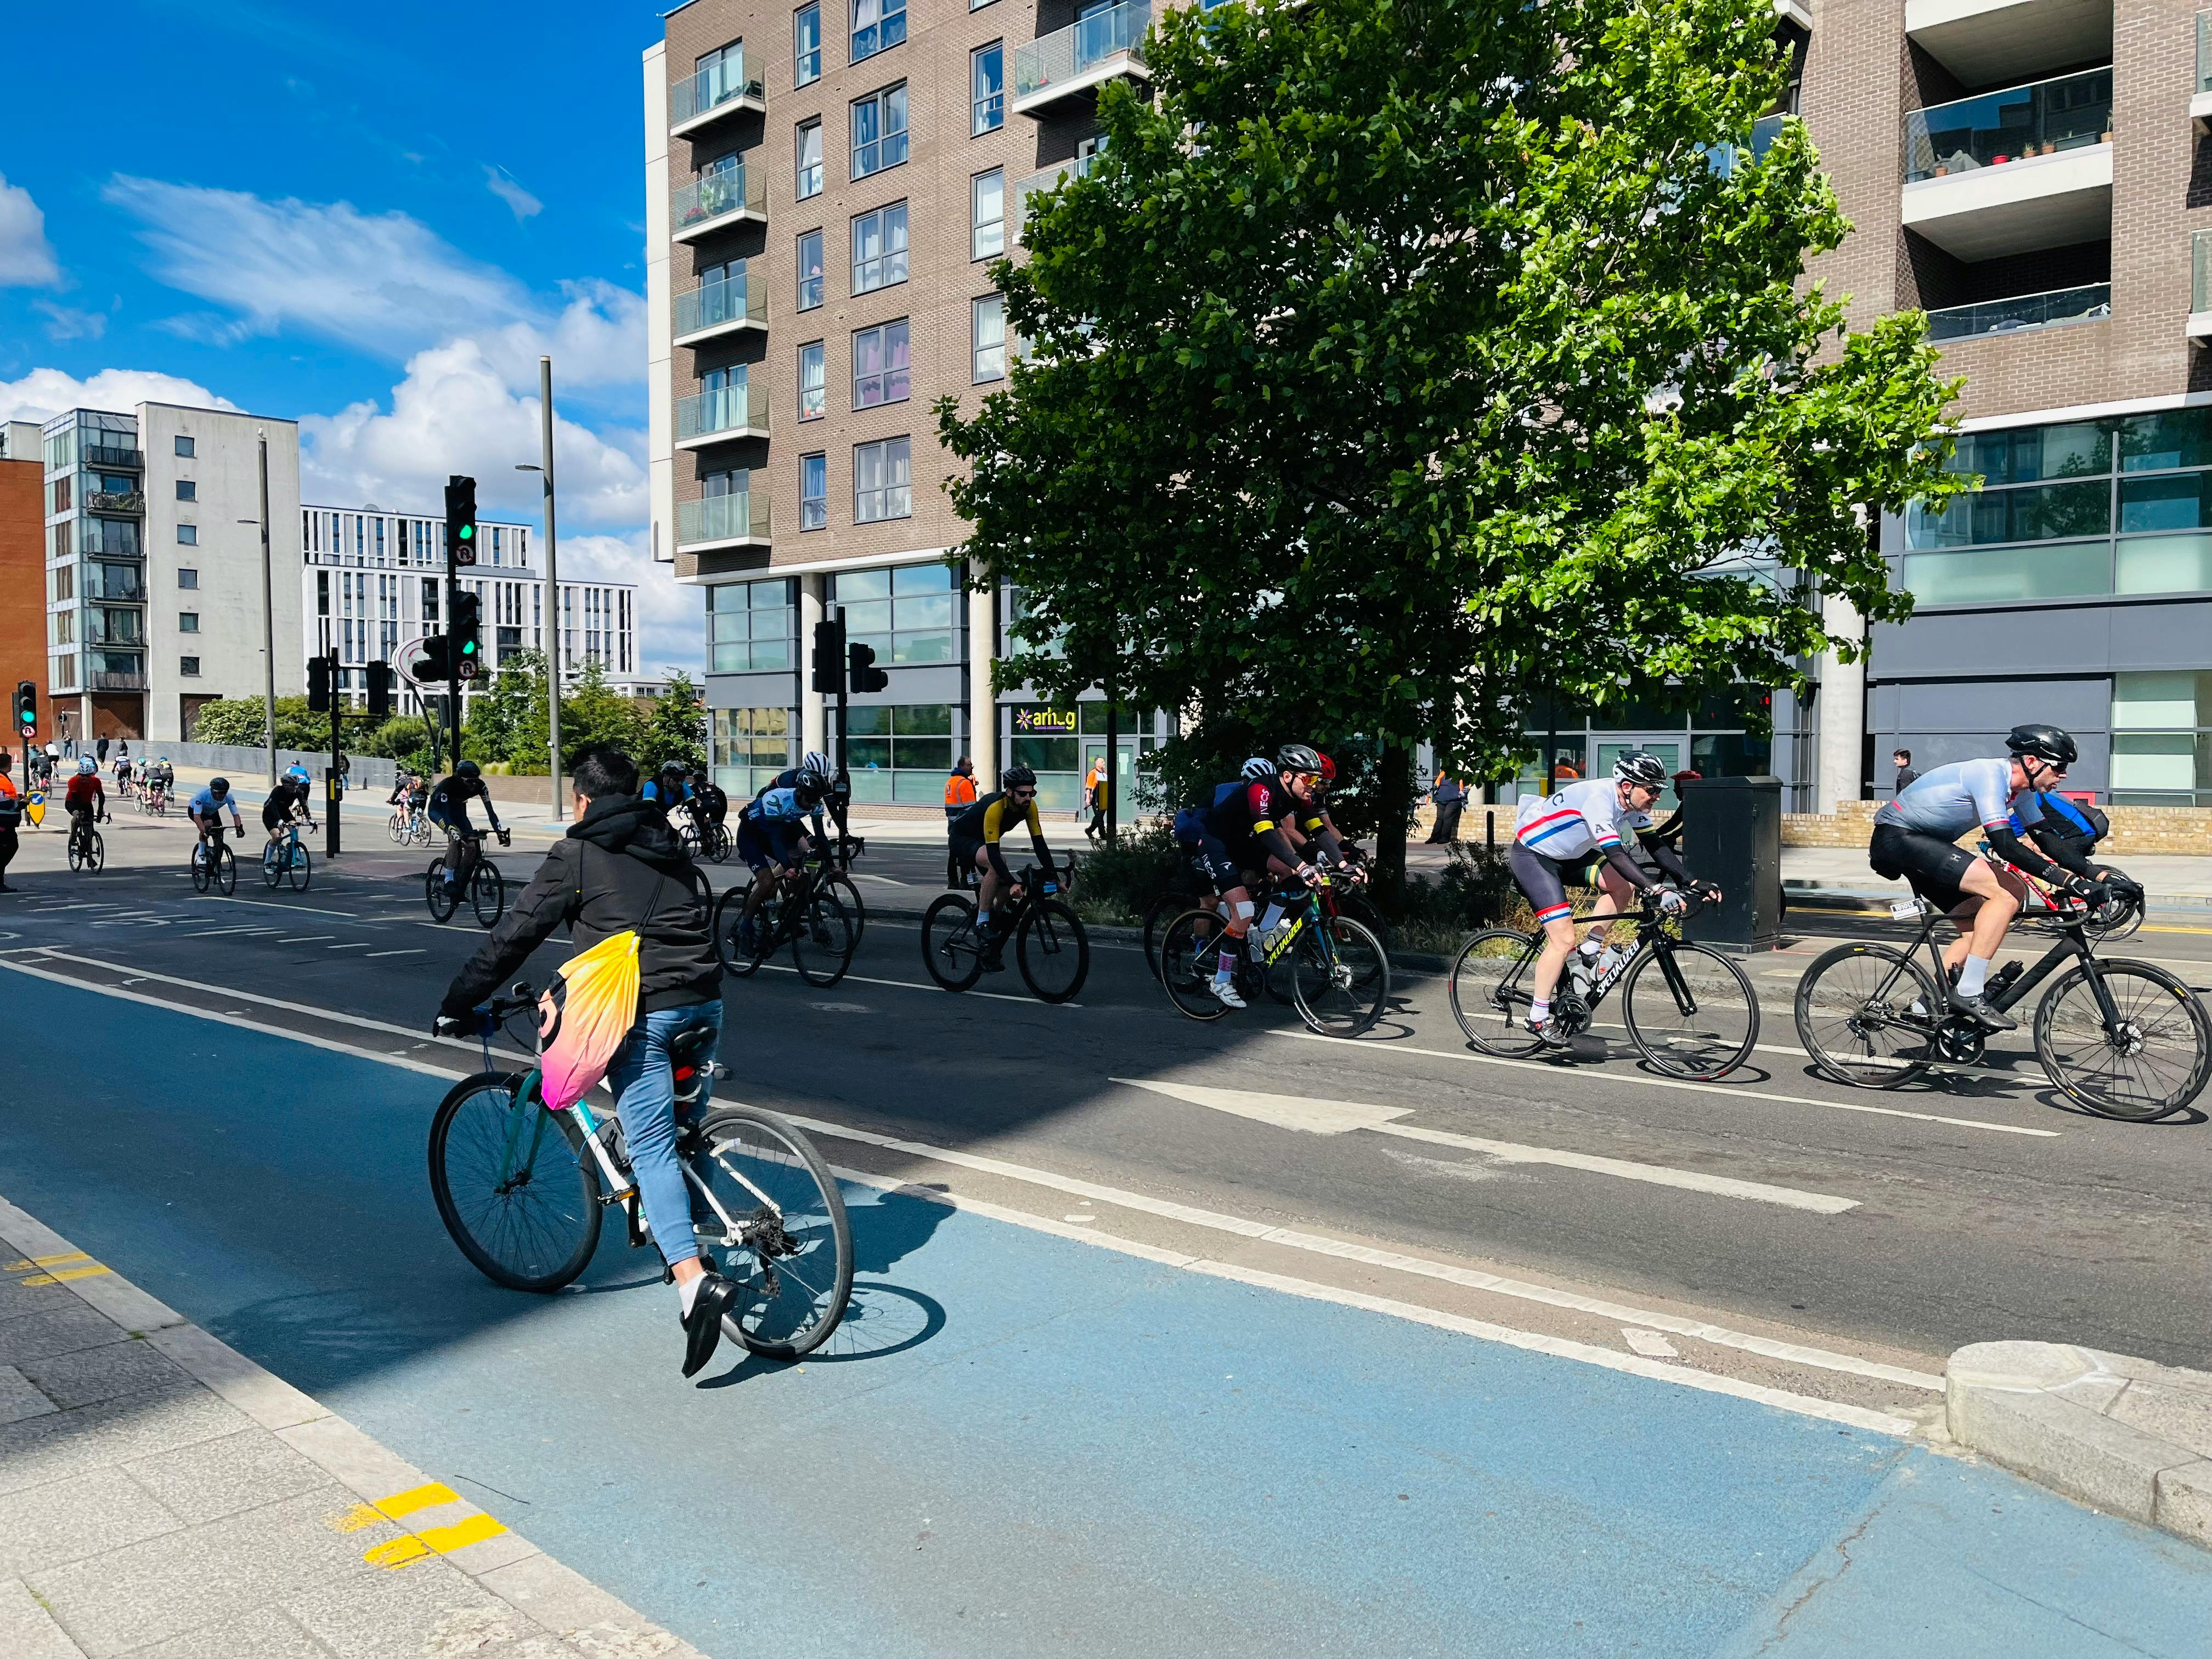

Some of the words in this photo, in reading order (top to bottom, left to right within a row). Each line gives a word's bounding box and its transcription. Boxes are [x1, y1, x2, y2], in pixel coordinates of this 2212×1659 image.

[1260, 788, 1269, 815] INEOS
[1201, 854, 1216, 879] INEOS
[1266, 917, 1302, 968] SPECIALIZED
[1596, 939, 1640, 997] SPECIALIZED
